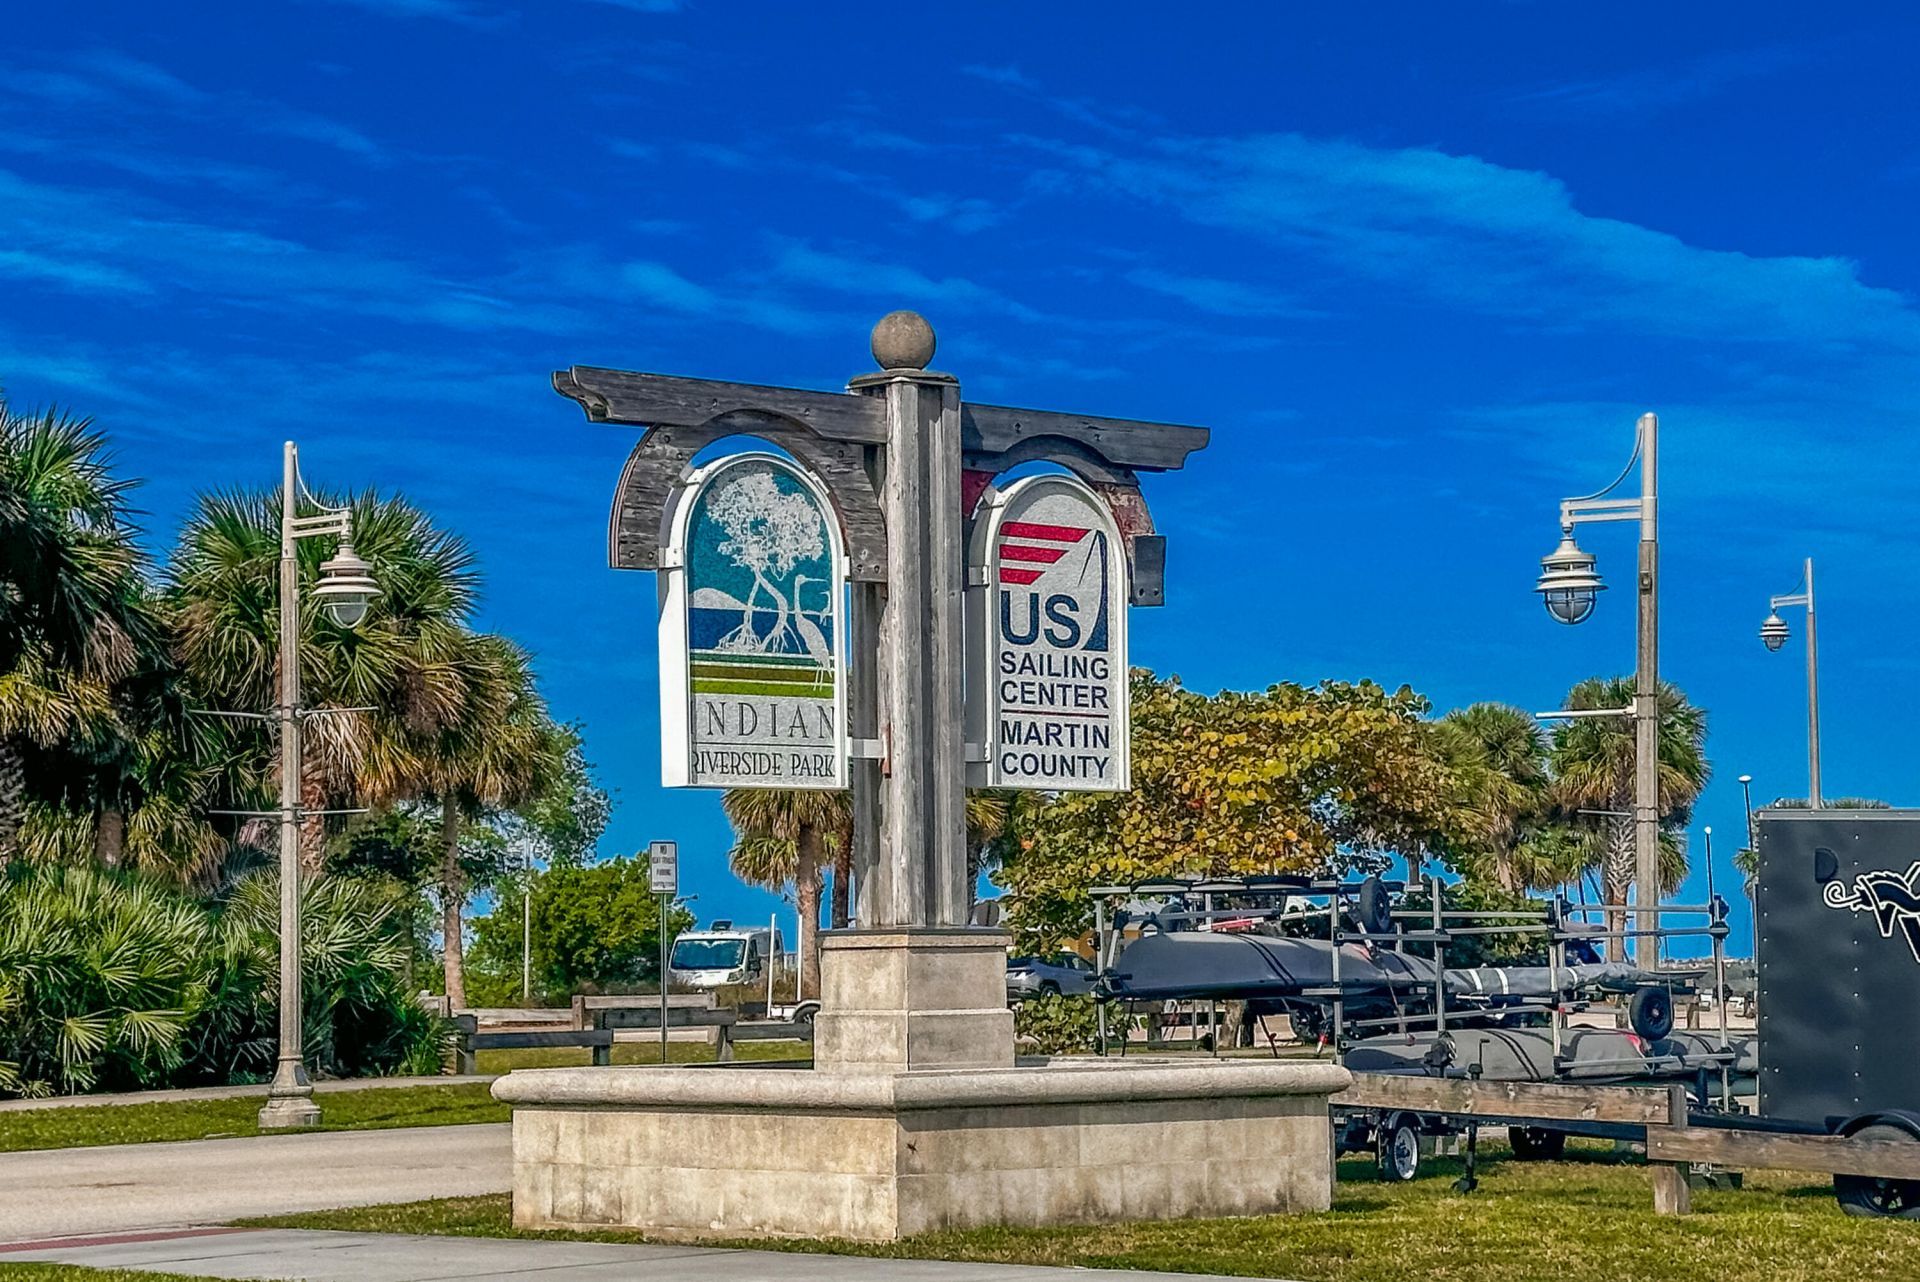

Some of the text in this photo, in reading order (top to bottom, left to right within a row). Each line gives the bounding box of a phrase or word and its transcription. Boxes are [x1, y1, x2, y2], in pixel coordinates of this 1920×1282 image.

[1001, 590, 1080, 649] US
[1000, 651, 1109, 680] SAILING
[1001, 680, 1109, 708] CENTER
[1001, 720, 1110, 748] MARTIN
[791, 753, 835, 777] PARK
[1001, 752, 1110, 778] COUNTY
